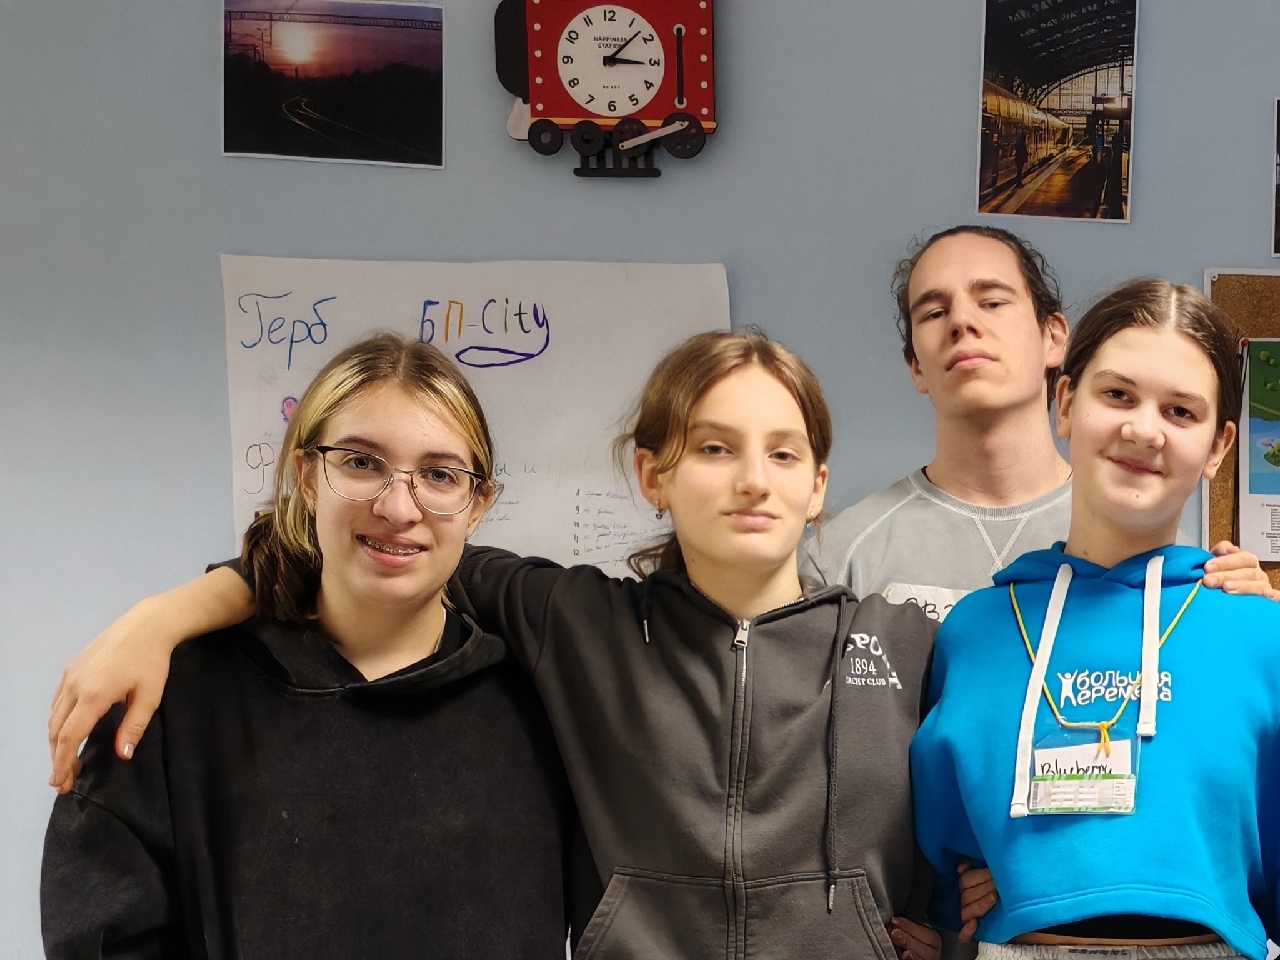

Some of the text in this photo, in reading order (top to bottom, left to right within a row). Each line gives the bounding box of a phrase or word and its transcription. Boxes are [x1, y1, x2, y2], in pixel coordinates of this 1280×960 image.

[604, 9, 616, 21] 12
[583, 15, 593, 27] 11
[629, 17, 636, 28] 1
[565, 30, 578, 44] 10
[642, 34, 654, 45] 2
[562, 55, 573, 64] 9
[649, 58, 660, 66] 3
[568, 78, 579, 88] 8
[644, 80, 654, 90] 4
[585, 94, 595, 104] 7
[629, 94, 639, 106] 5
[608, 101, 616, 112] 6
[238, 291, 337, 371] Герб
[850, 657, 877, 675] 1894
